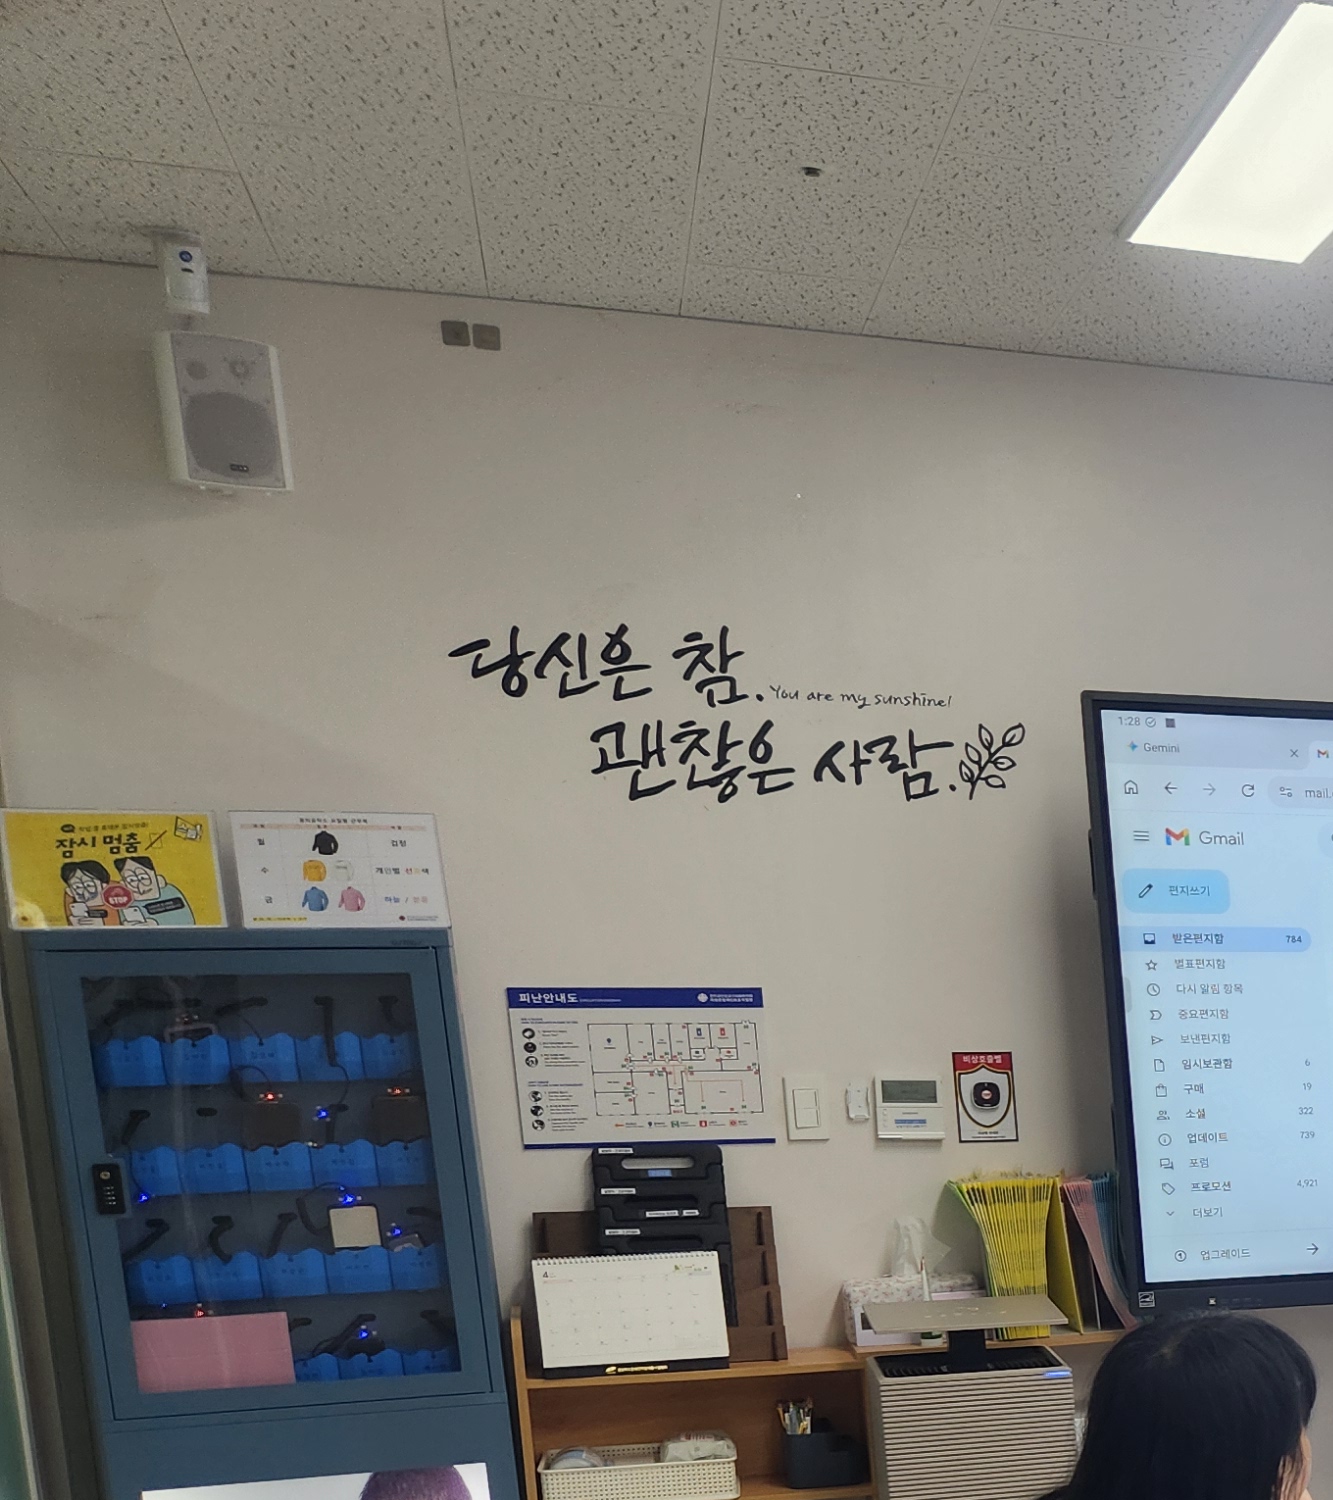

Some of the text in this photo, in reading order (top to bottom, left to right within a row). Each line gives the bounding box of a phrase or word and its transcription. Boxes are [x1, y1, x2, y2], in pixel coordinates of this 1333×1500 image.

[447, 623, 765, 707] 당신은 참.
[769, 684, 952, 708] You are my sunshine!
[1117, 716, 1141, 727] 1:28
[1143, 741, 1180, 755] Gemini
[589, 719, 957, 803] 괜찮은 사람.
[1199, 829, 1245, 847] Gmail
[55, 832, 142, 859] 잠시 멈춤
[1168, 884, 1211, 899] 편지쓰기
[108, 896, 129, 905] STOP
[1172, 933, 1303, 945] 받은편지함 784
[1174, 958, 1226, 970] 별표편지함
[1176, 984, 1197, 995] 다시
[1199, 984, 1221, 995] 알림
[518, 992, 579, 1004] 피난안내도
[1178, 1008, 1229, 1020] 중요편지함
[1180, 1033, 1231, 1045] 보낸편지함
[962, 1054, 1003, 1064] 비상호출벨
[1181, 1058, 1233, 1070] 임시보관함
[1183, 1082, 1312, 1095] 구매 19
[1185, 1106, 1314, 1120] 소셜 322
[1187, 1131, 1315, 1144] 업데이트 739
[1189, 1157, 1210, 1169] 포럼
[1190, 1178, 1319, 1193] 프로모션 4,921
[1192, 1206, 1224, 1219] 더보기
[1200, 1248, 1251, 1261] 업그레이드
